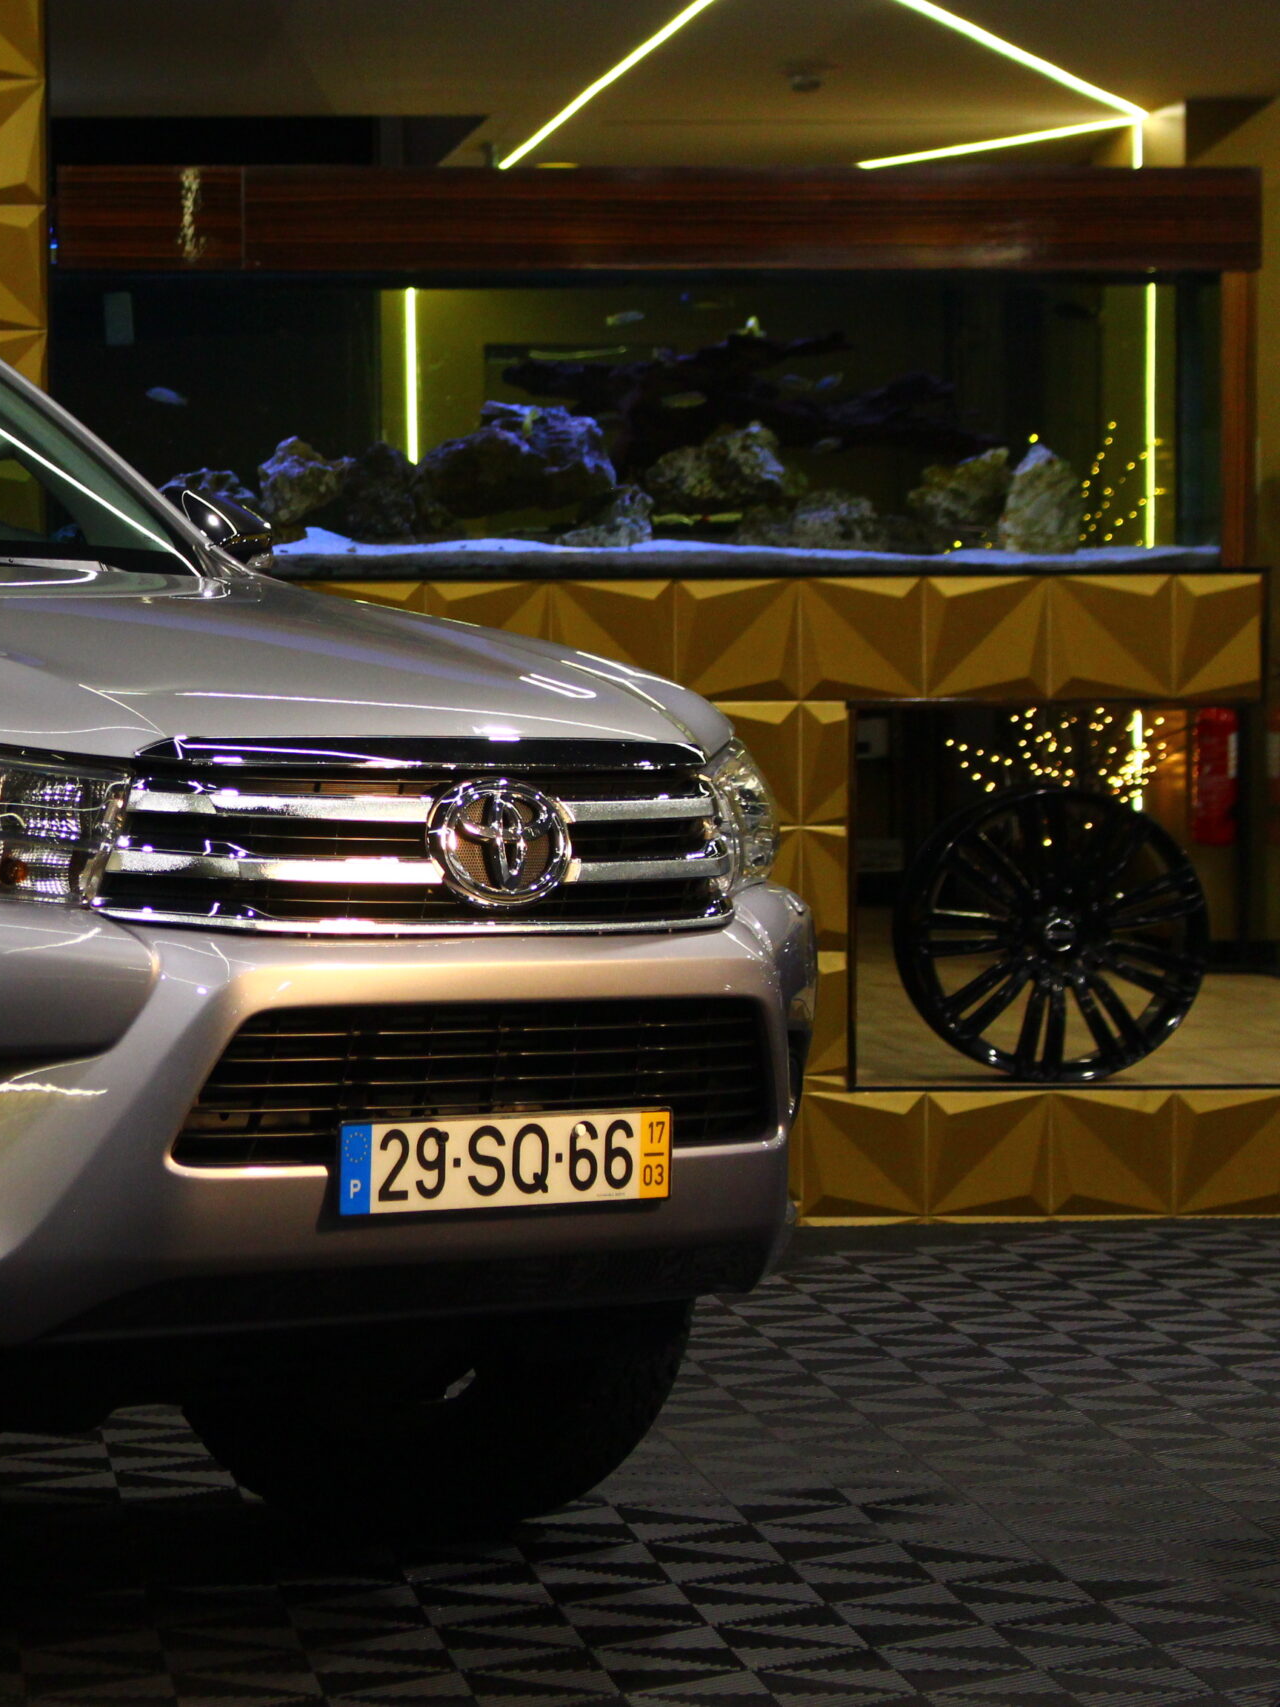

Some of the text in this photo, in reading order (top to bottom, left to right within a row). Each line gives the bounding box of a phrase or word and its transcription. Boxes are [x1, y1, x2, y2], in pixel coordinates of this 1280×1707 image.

[647, 1121, 666, 1145] 17
[642, 1163, 665, 1187] 03
[349, 1179, 362, 1200] P
